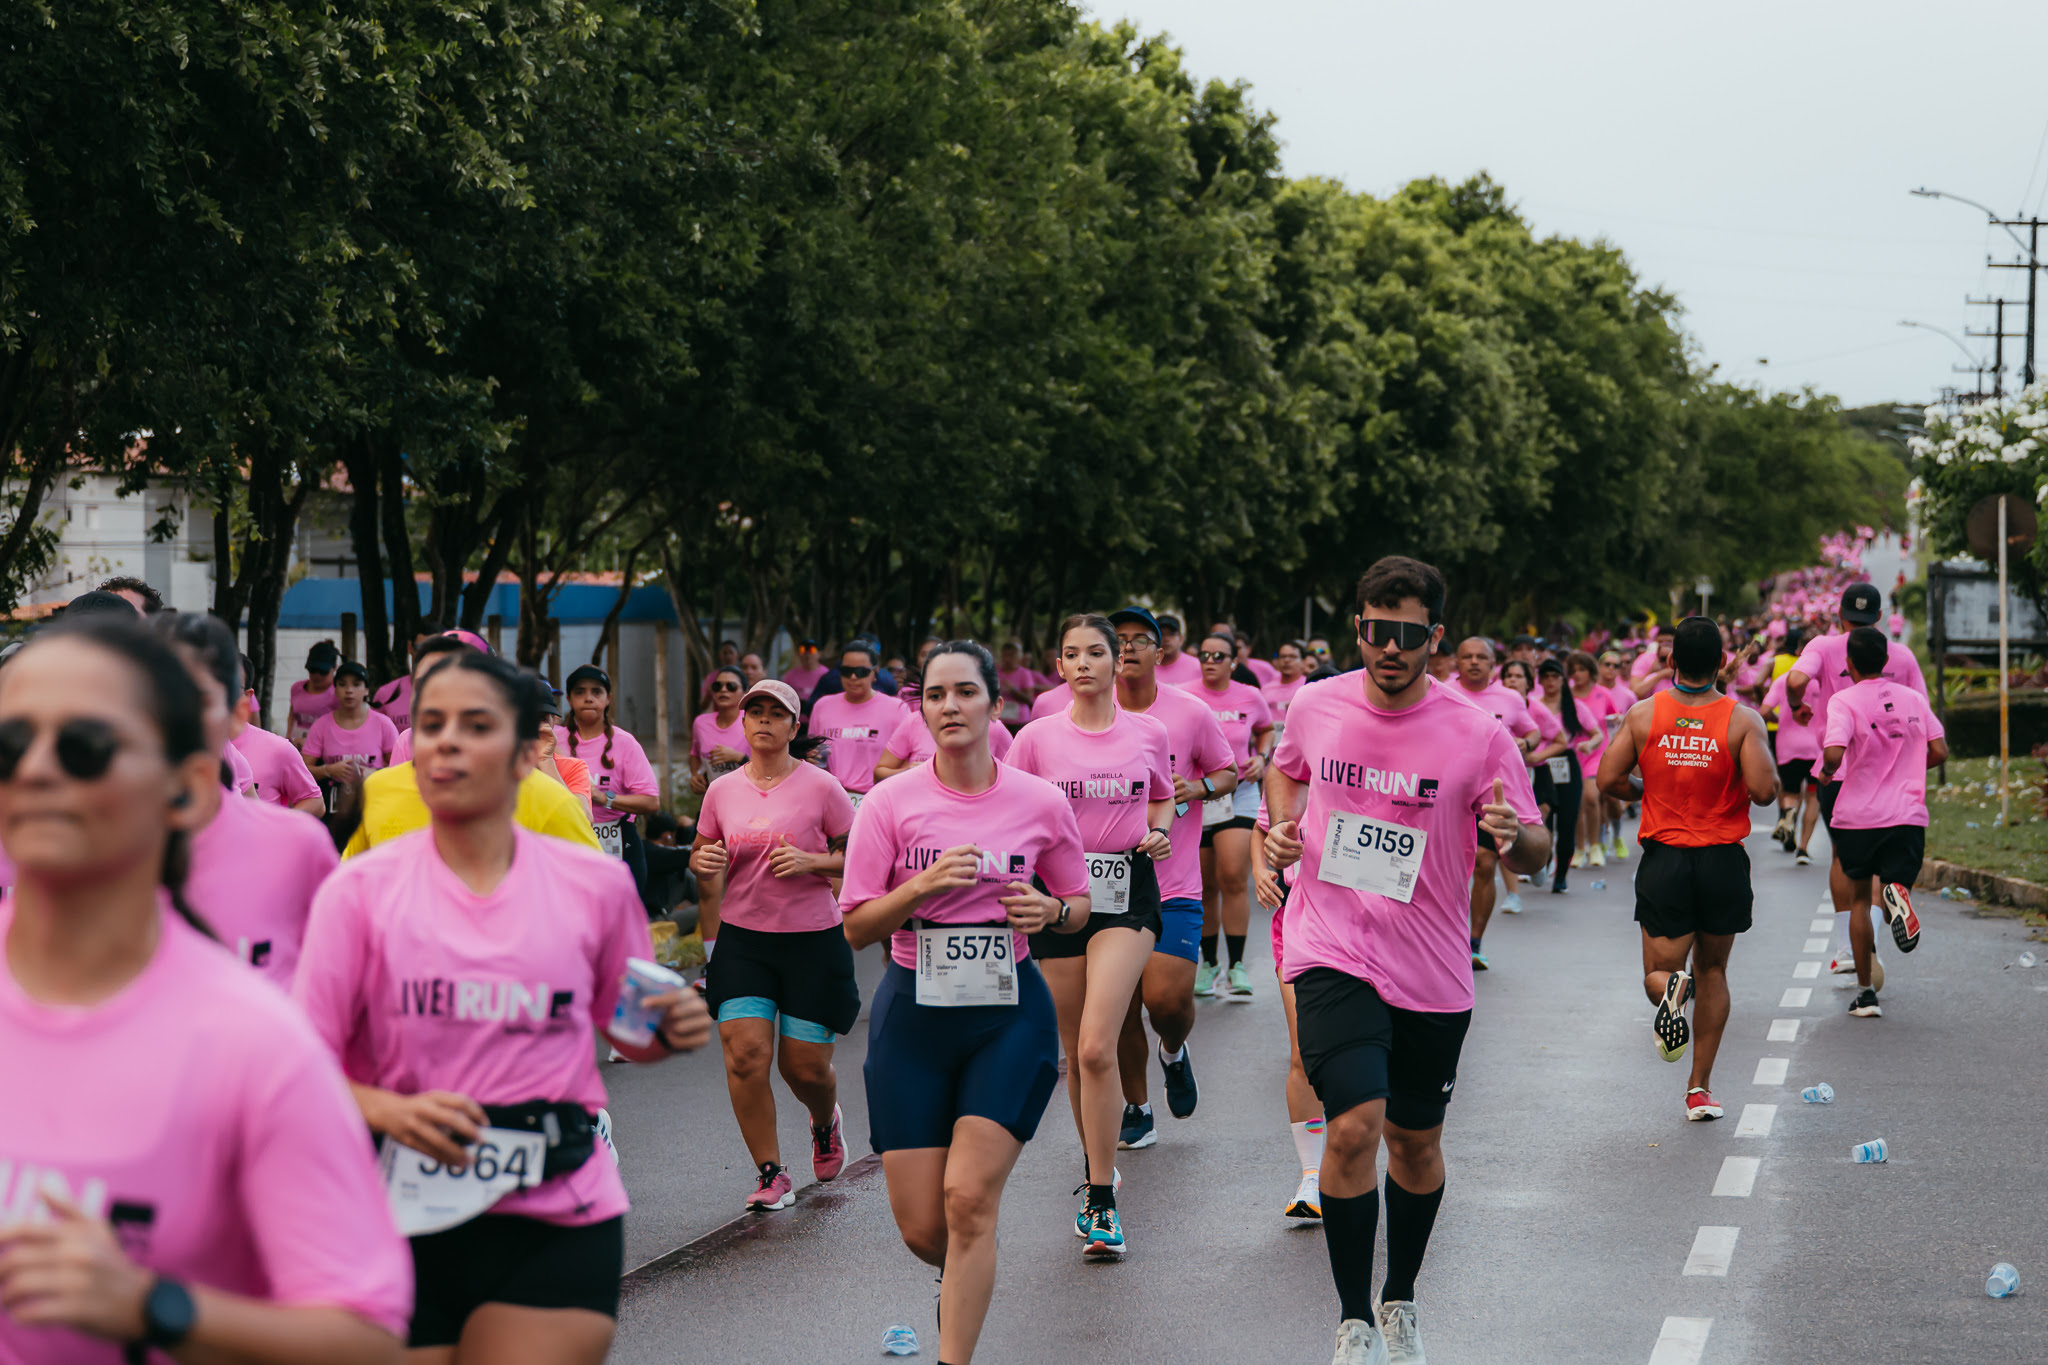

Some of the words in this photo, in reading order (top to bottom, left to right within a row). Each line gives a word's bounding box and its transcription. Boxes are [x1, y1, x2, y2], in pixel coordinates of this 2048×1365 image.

[1657, 734, 1719, 753] ATLETA
[1667, 760, 1708, 768] MOVIMENTO
[1679, 753, 1701, 761] FORÇA
[1357, 824, 1414, 857] 5159
[946, 936, 1007, 960] 5575
